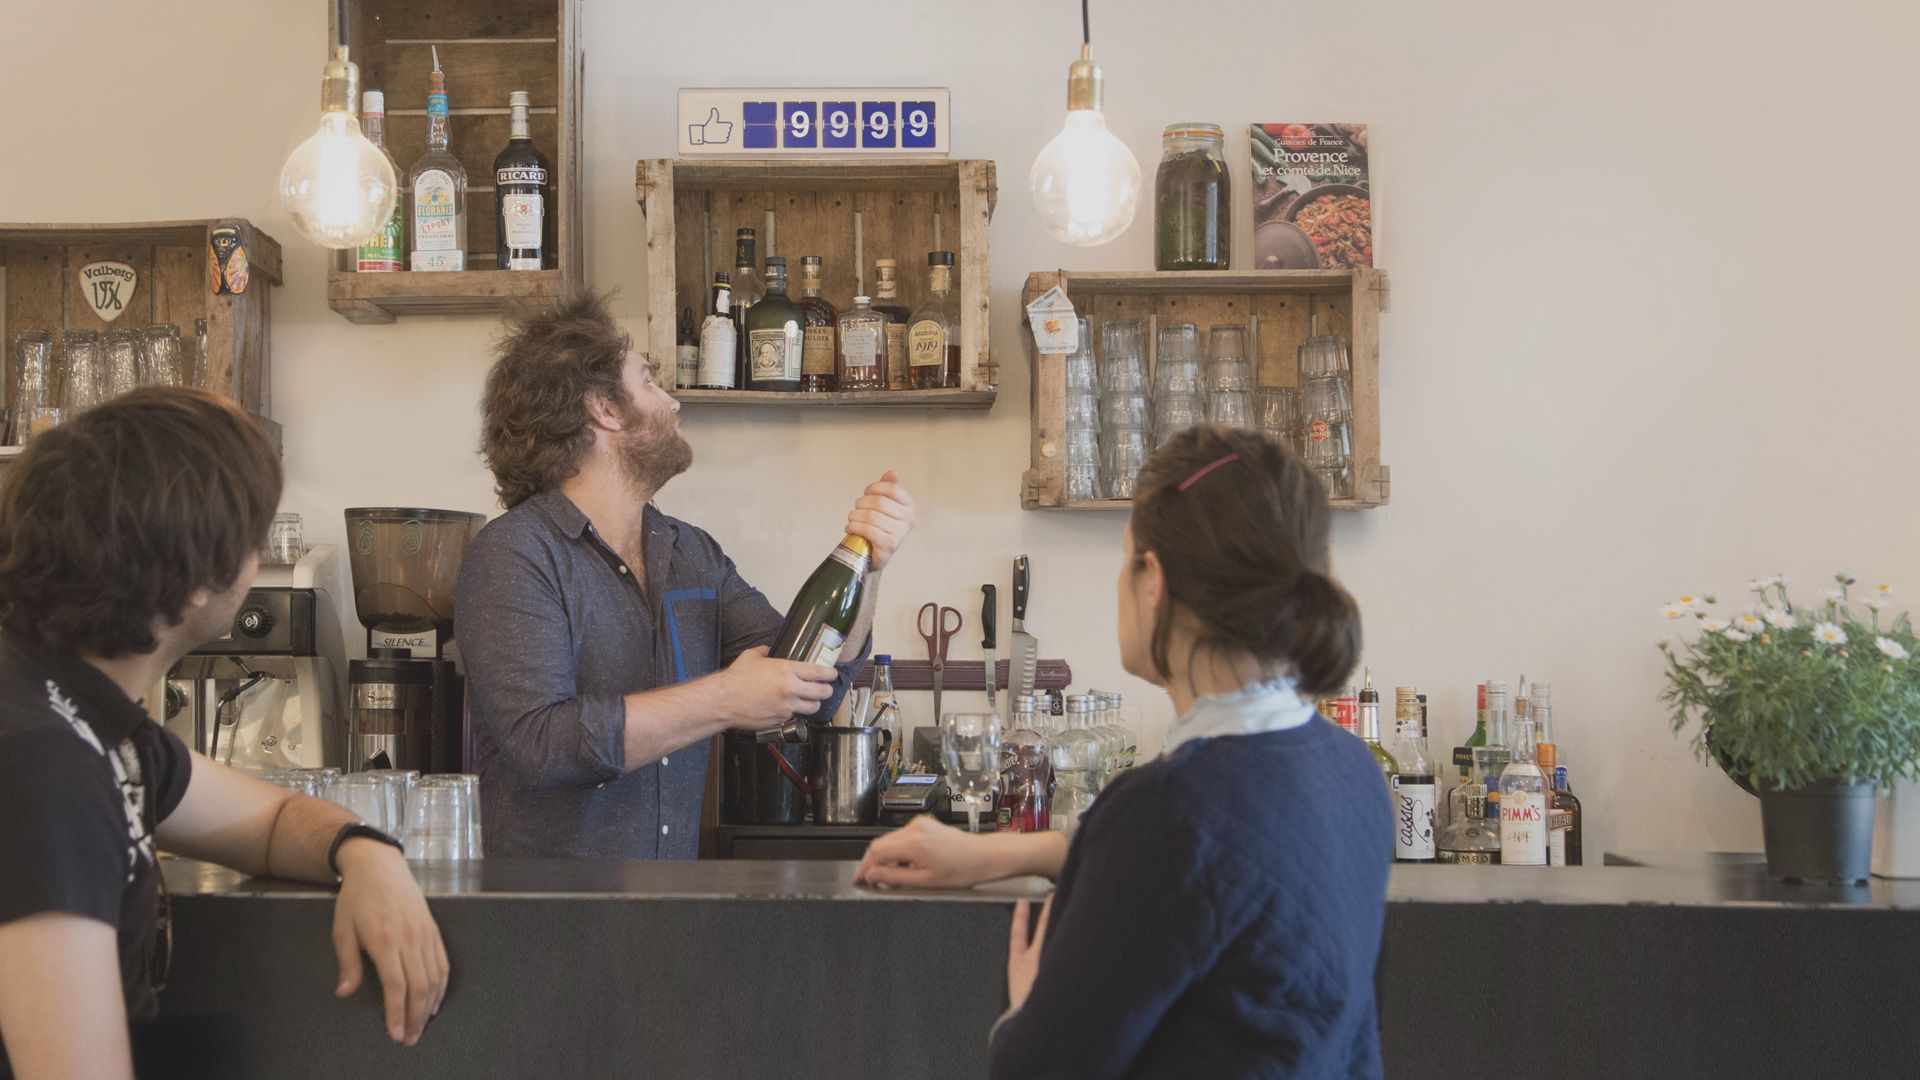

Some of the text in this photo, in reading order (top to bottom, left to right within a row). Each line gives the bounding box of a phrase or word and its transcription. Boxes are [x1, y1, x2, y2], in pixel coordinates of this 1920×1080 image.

[1274, 138, 1344, 146] Cuisines de France
[1273, 148, 1349, 163] Provence
[1263, 164, 1361, 176] et comté de Nice
[500, 171, 545, 182] RICARD
[417, 206, 453, 217] FLORANIS
[421, 219, 450, 233] EXPORT
[83, 266, 135, 282] Valberg
[916, 340, 938, 352] 1919
[383, 638, 425, 647] SILENCE
[1502, 805, 1541, 821] PIMM'S
